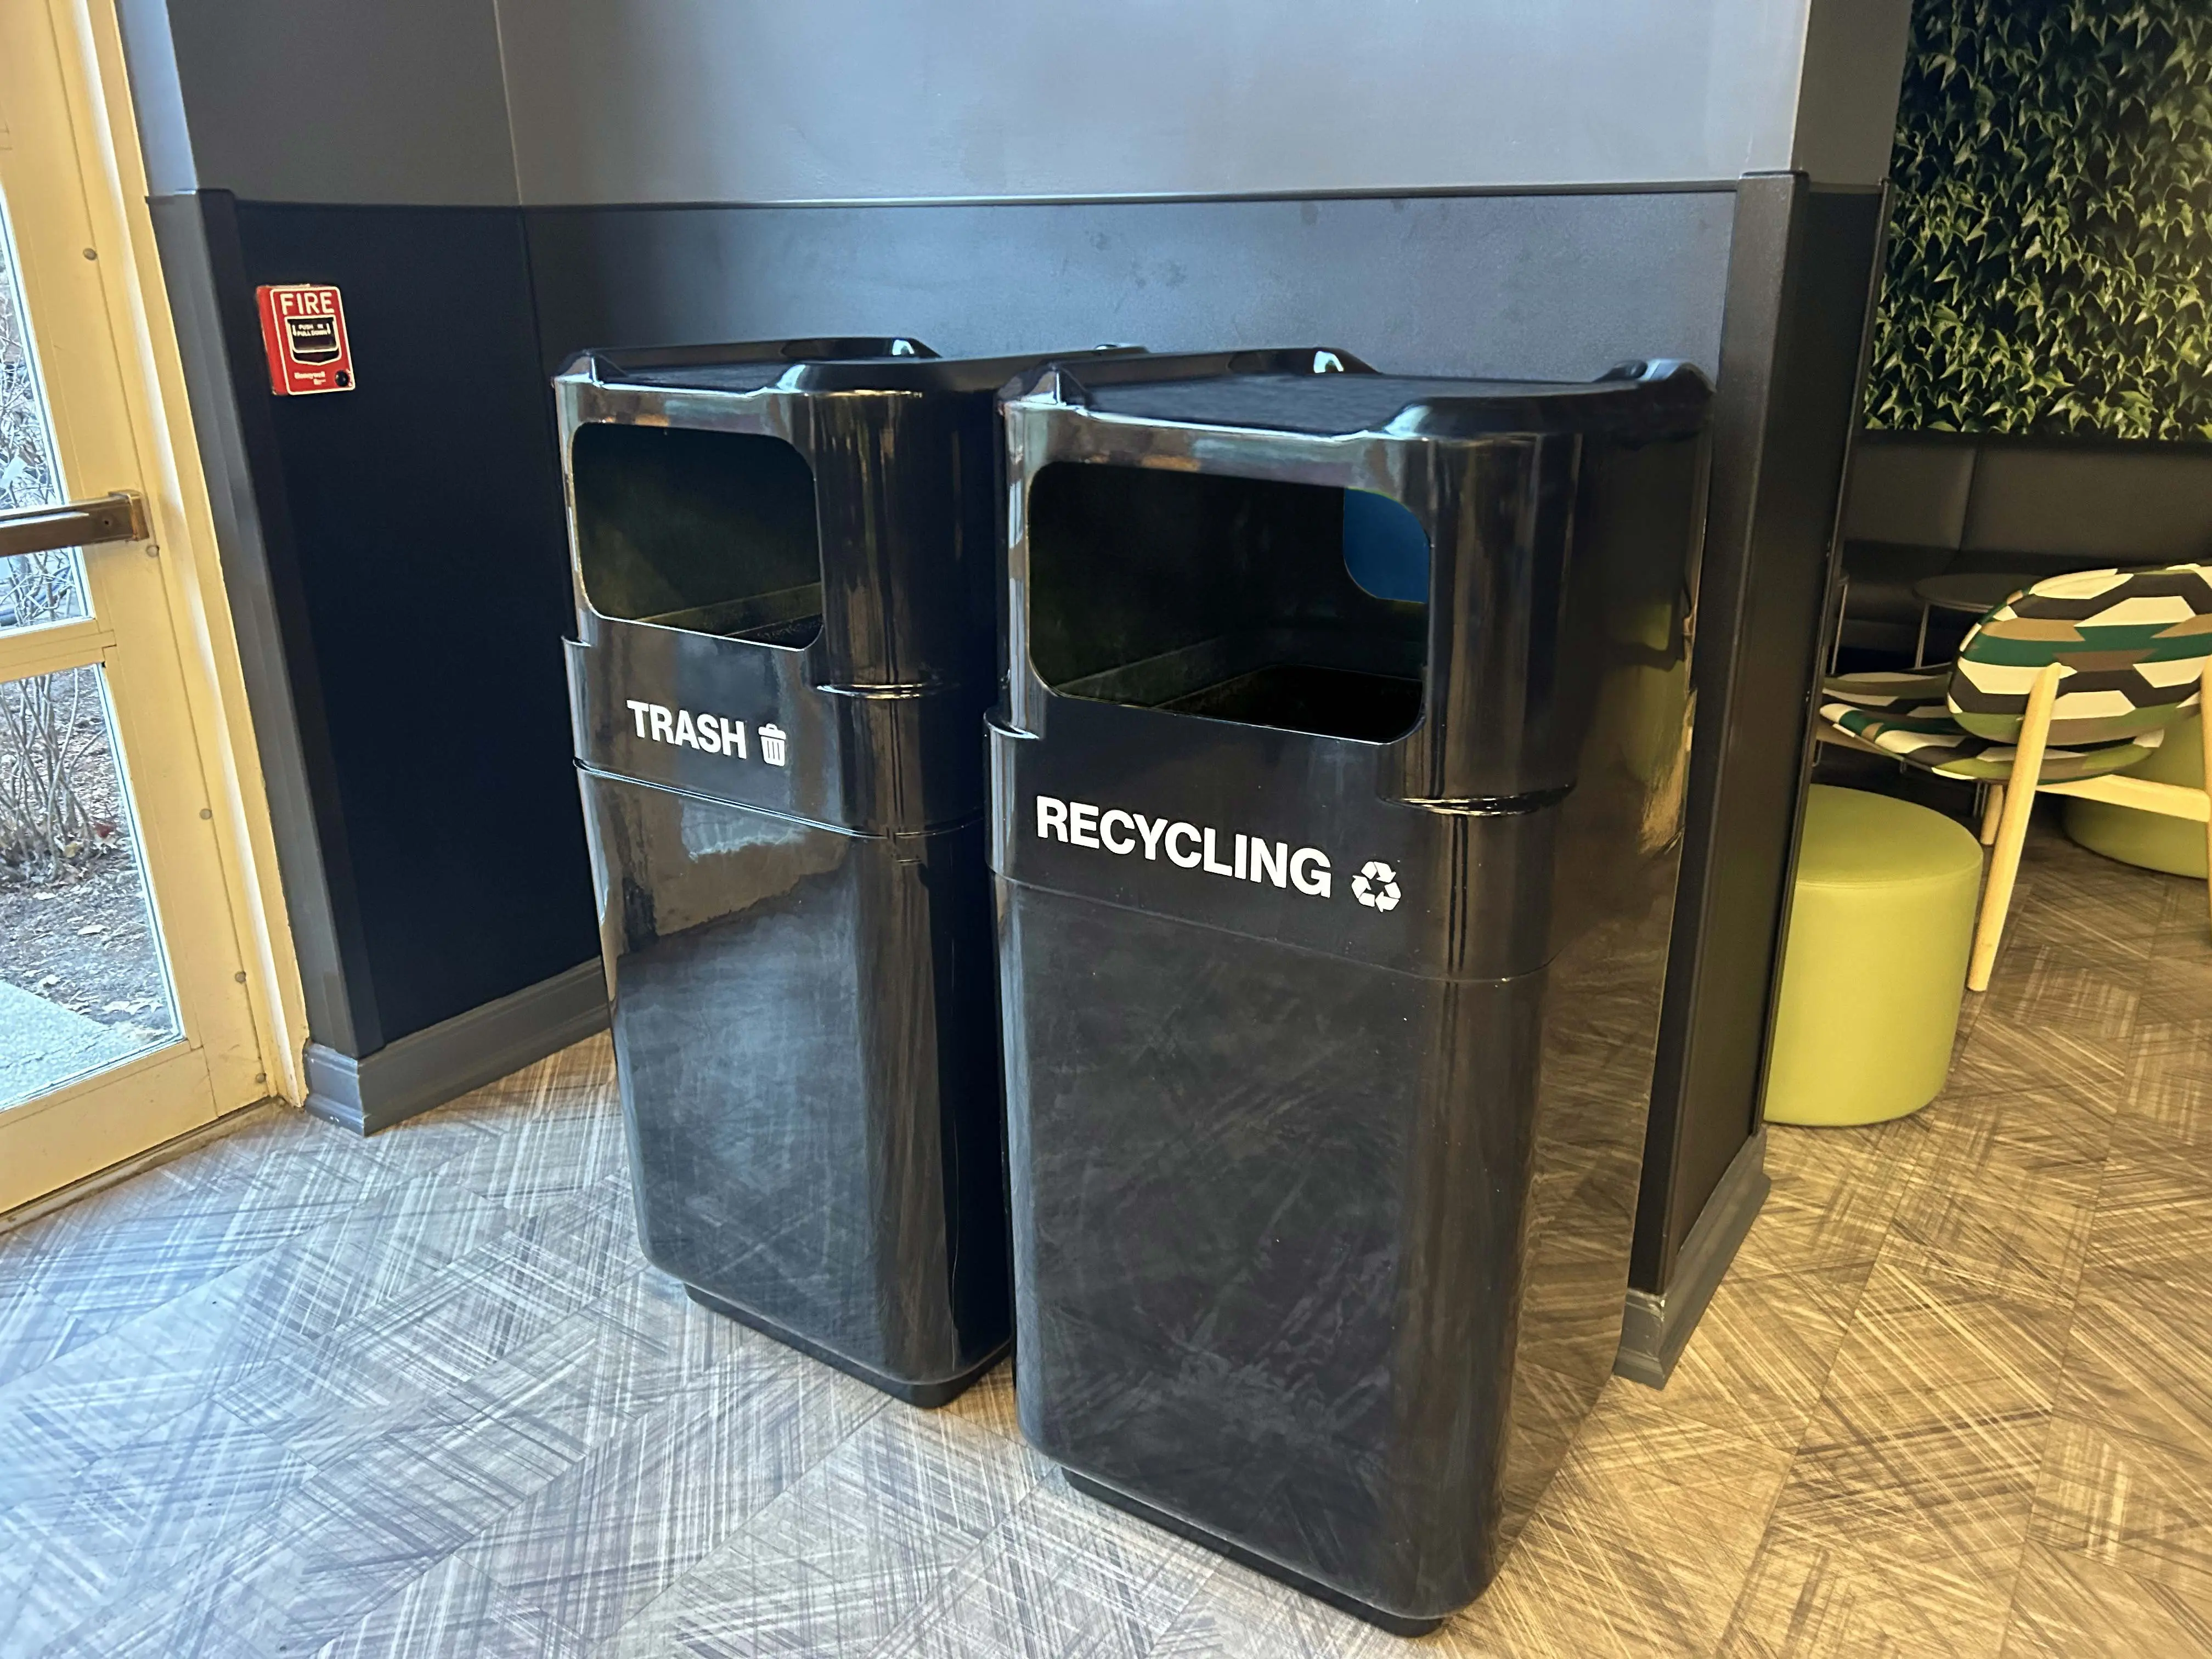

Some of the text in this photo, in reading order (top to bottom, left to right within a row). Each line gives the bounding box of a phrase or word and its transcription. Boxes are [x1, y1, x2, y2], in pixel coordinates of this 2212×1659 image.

[280, 292, 334, 315] FIRE
[627, 700, 747, 759] TRASH
[1037, 796, 1331, 898] RECYCLING
